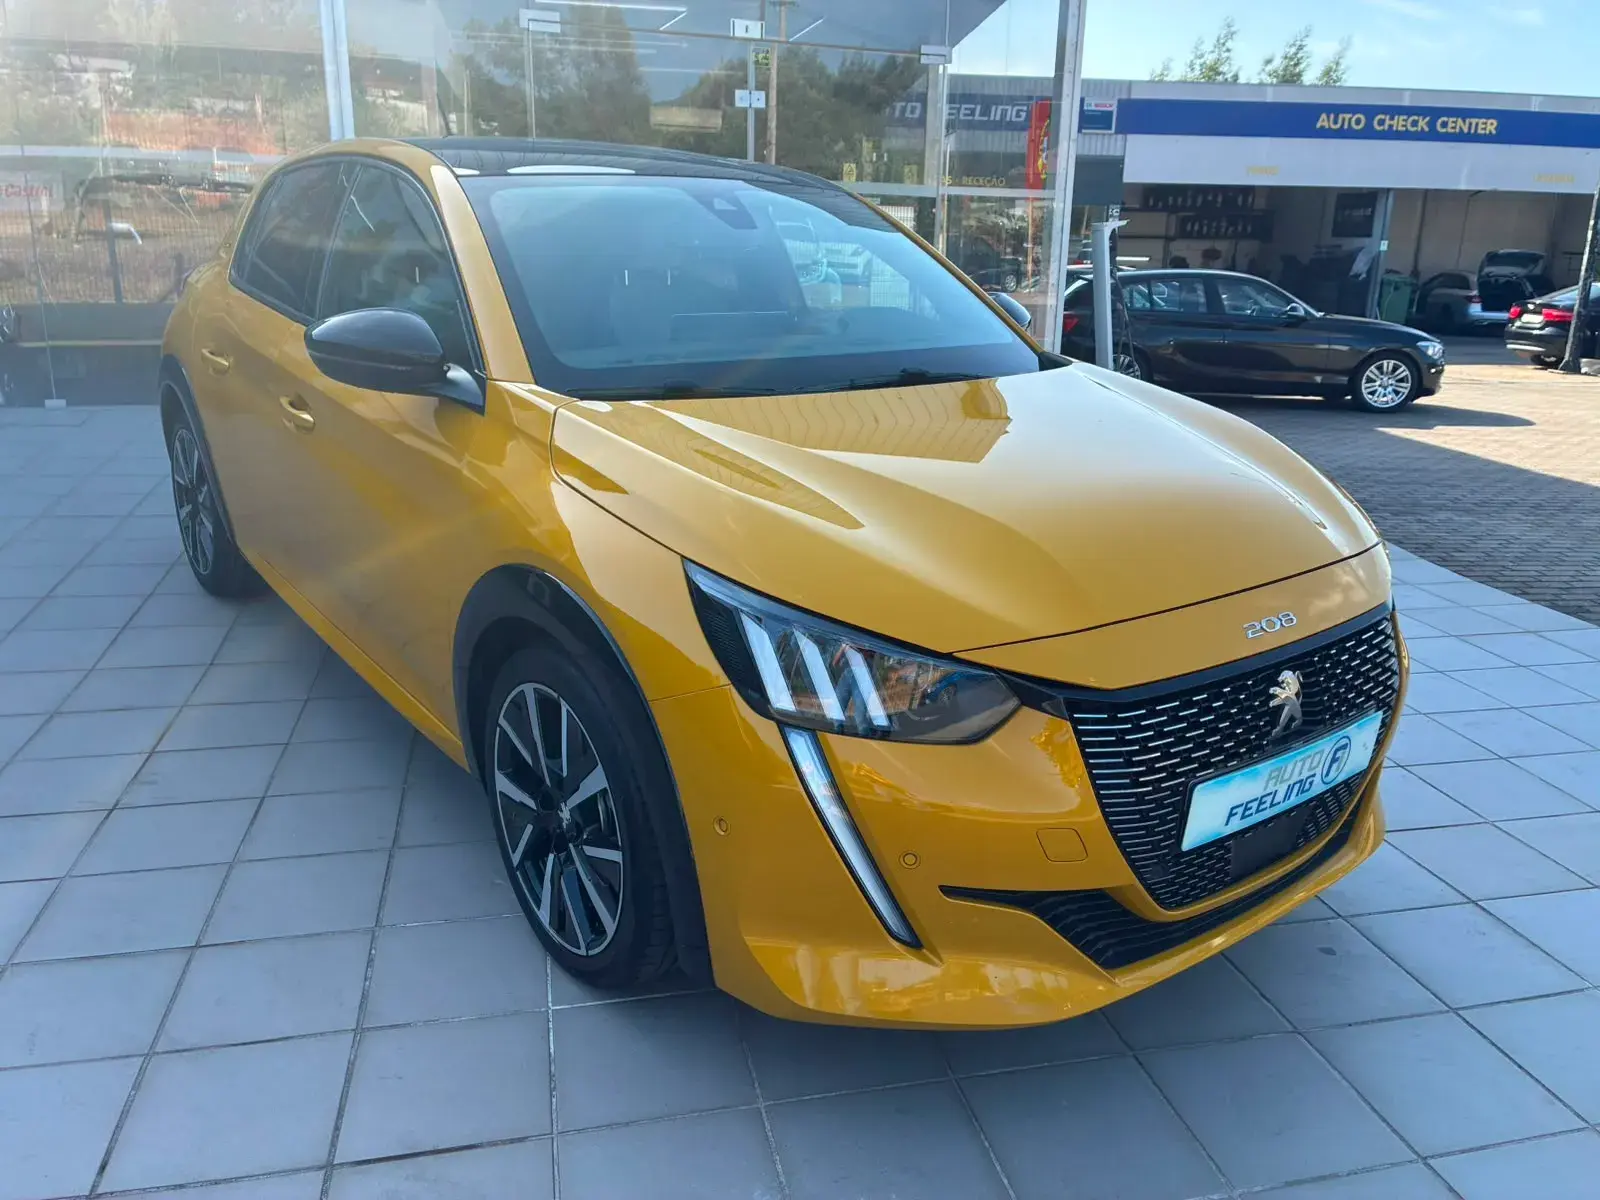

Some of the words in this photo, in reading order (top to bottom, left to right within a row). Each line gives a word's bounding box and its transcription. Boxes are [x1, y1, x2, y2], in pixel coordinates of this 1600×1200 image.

[882, 102, 922, 118] TO
[943, 103, 1028, 121] EELING
[1316, 113, 1366, 130] AUTO
[1373, 114, 1431, 132] CHECK
[1436, 117, 1498, 135] CENTER
[1243, 611, 1297, 639] 208
[1264, 749, 1325, 790] AUTO
[1224, 773, 1316, 826] FEELING
